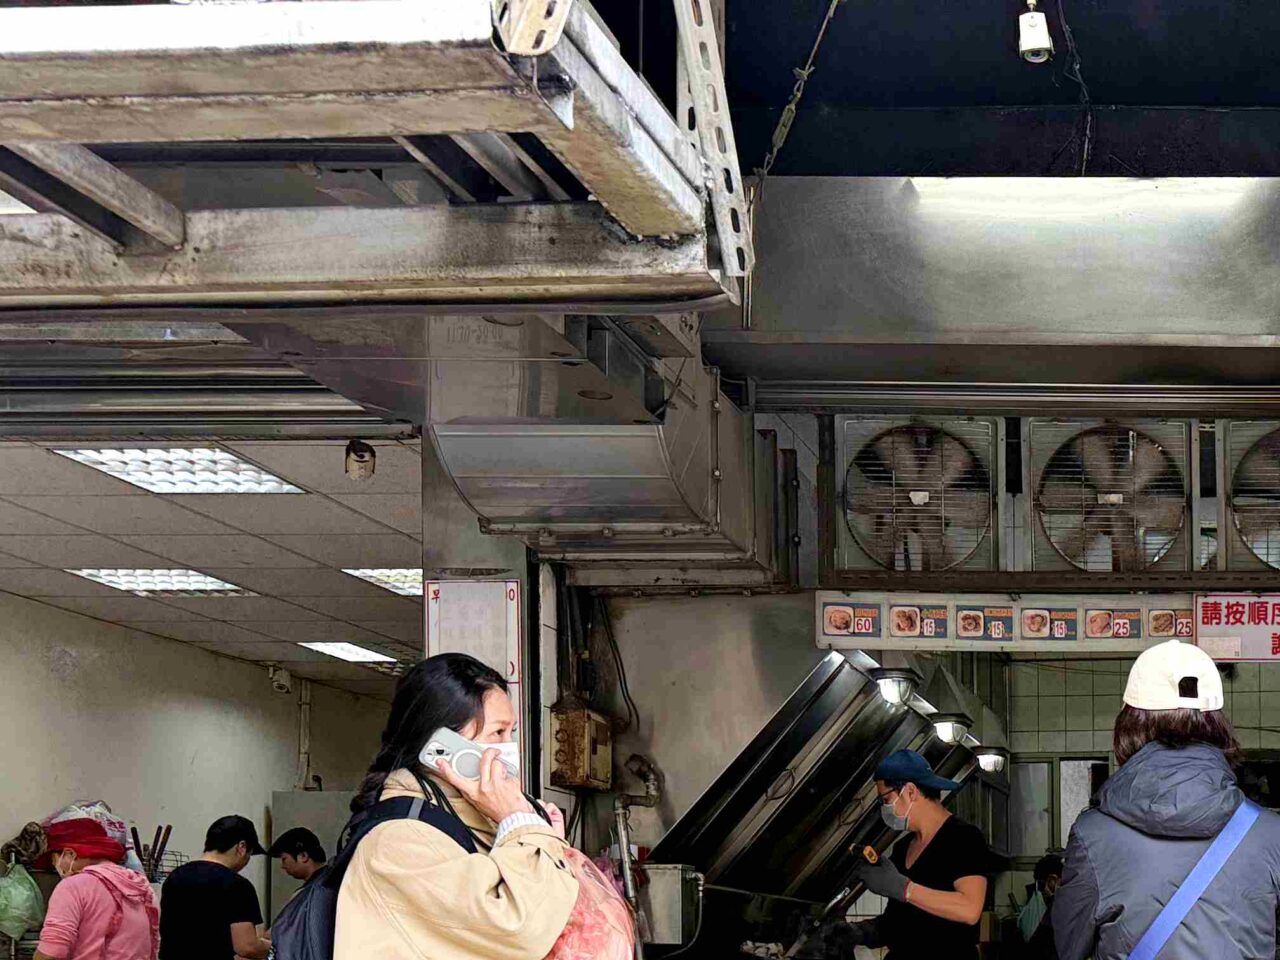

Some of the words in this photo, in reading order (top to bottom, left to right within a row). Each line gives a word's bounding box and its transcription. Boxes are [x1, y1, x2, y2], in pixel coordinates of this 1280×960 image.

[856, 618, 871, 632] 60
[924, 620, 935, 634] 15
[993, 621, 1002, 637] 15
[1056, 622, 1065, 637] 15
[1115, 621, 1129, 635] 25
[1178, 621, 1192, 635] 25
